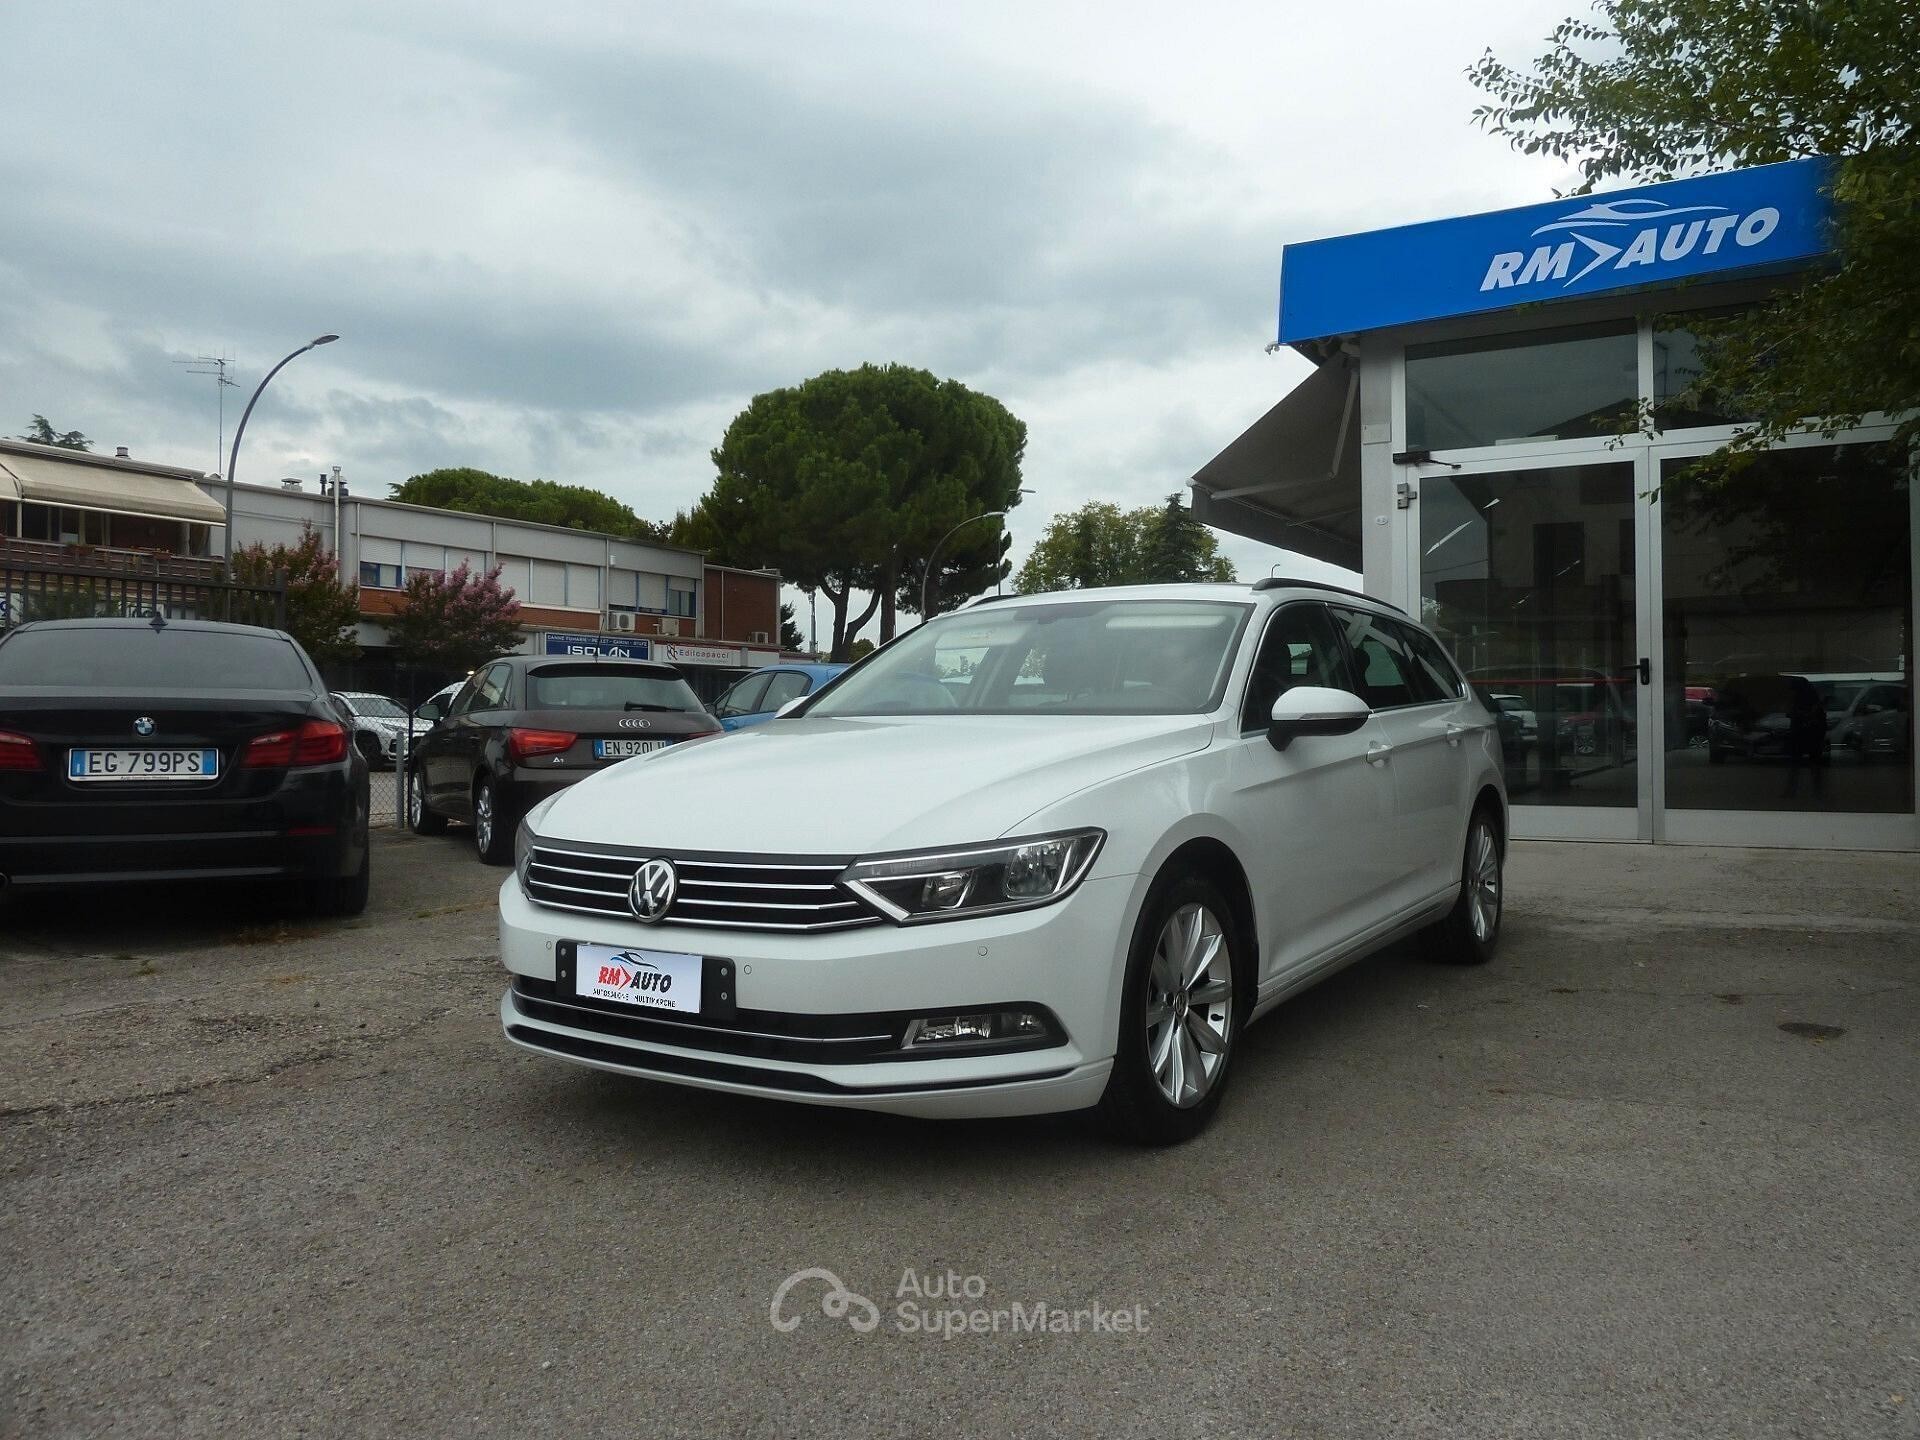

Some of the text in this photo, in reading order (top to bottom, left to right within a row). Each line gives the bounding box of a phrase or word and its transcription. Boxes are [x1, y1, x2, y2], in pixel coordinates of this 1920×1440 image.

[1479, 206, 1780, 292] RM AUTO
[567, 645, 630, 658] ISOLAN
[605, 741, 621, 755] EN
[88, 752, 200, 774] EG 799PS
[597, 965, 672, 994] RM AUTO
